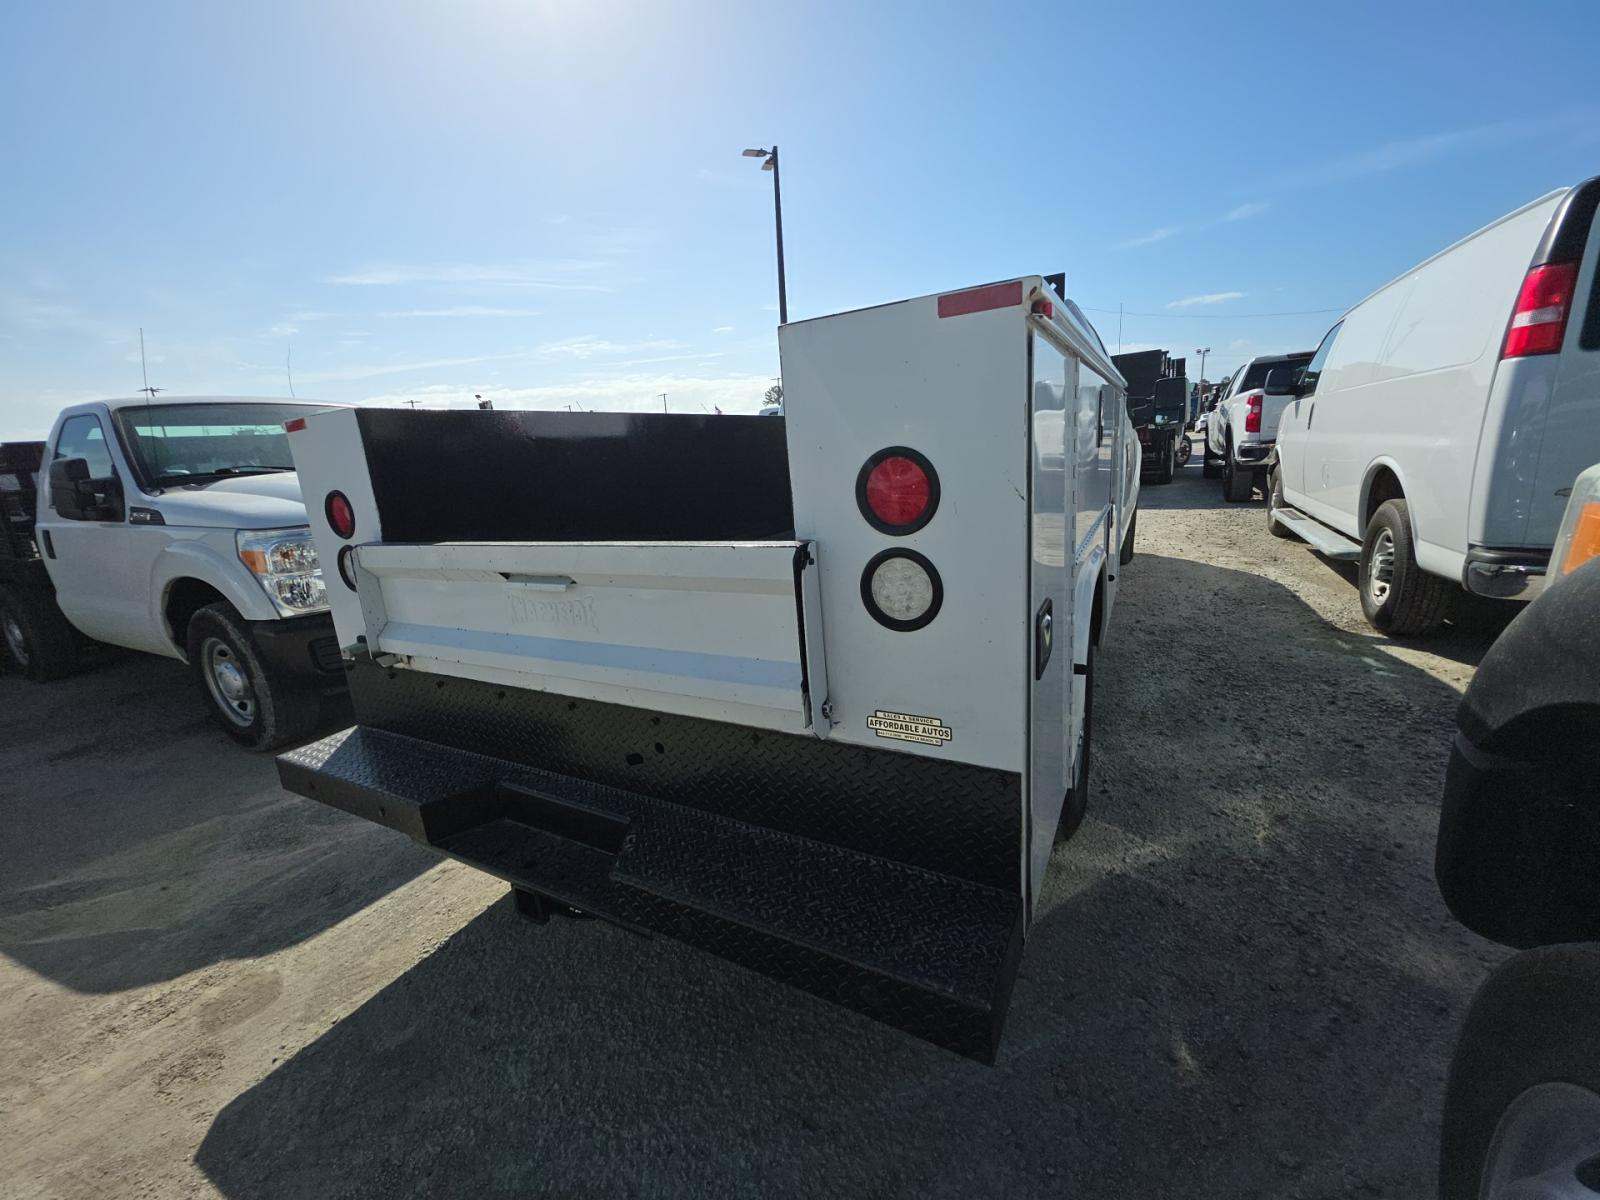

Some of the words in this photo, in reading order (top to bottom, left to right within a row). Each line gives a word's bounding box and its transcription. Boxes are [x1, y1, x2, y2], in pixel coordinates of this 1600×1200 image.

[883, 712, 901, 720] SALES
[908, 716, 934, 725] SERVICE
[869, 719, 920, 733] AFFORDABLE
[921, 726, 950, 738] AUTOS
